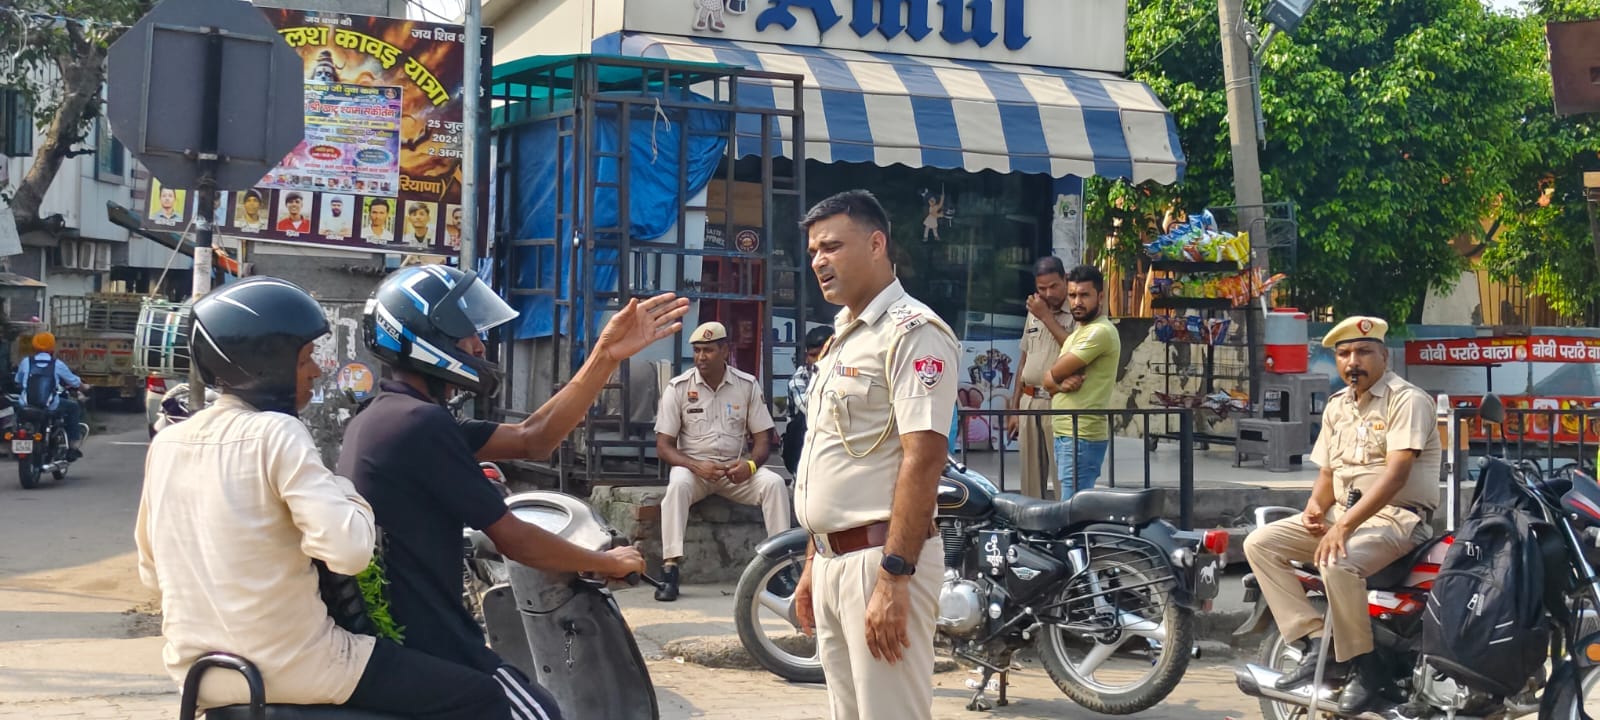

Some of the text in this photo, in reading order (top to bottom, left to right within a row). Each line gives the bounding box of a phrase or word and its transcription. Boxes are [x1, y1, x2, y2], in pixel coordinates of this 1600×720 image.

[411, 28, 432, 40] जय
[434, 26, 456, 42] शिव
[278, 26, 450, 106] लश कावड़ यात्रा
[428, 120, 464, 134] 25 जुल
[432, 134, 458, 143] 2024
[429, 148, 436, 156] 2
[399, 174, 447, 201] रियाणा)
[1482, 345, 1514, 360] वाला
[1588, 346, 1600, 359] वा
